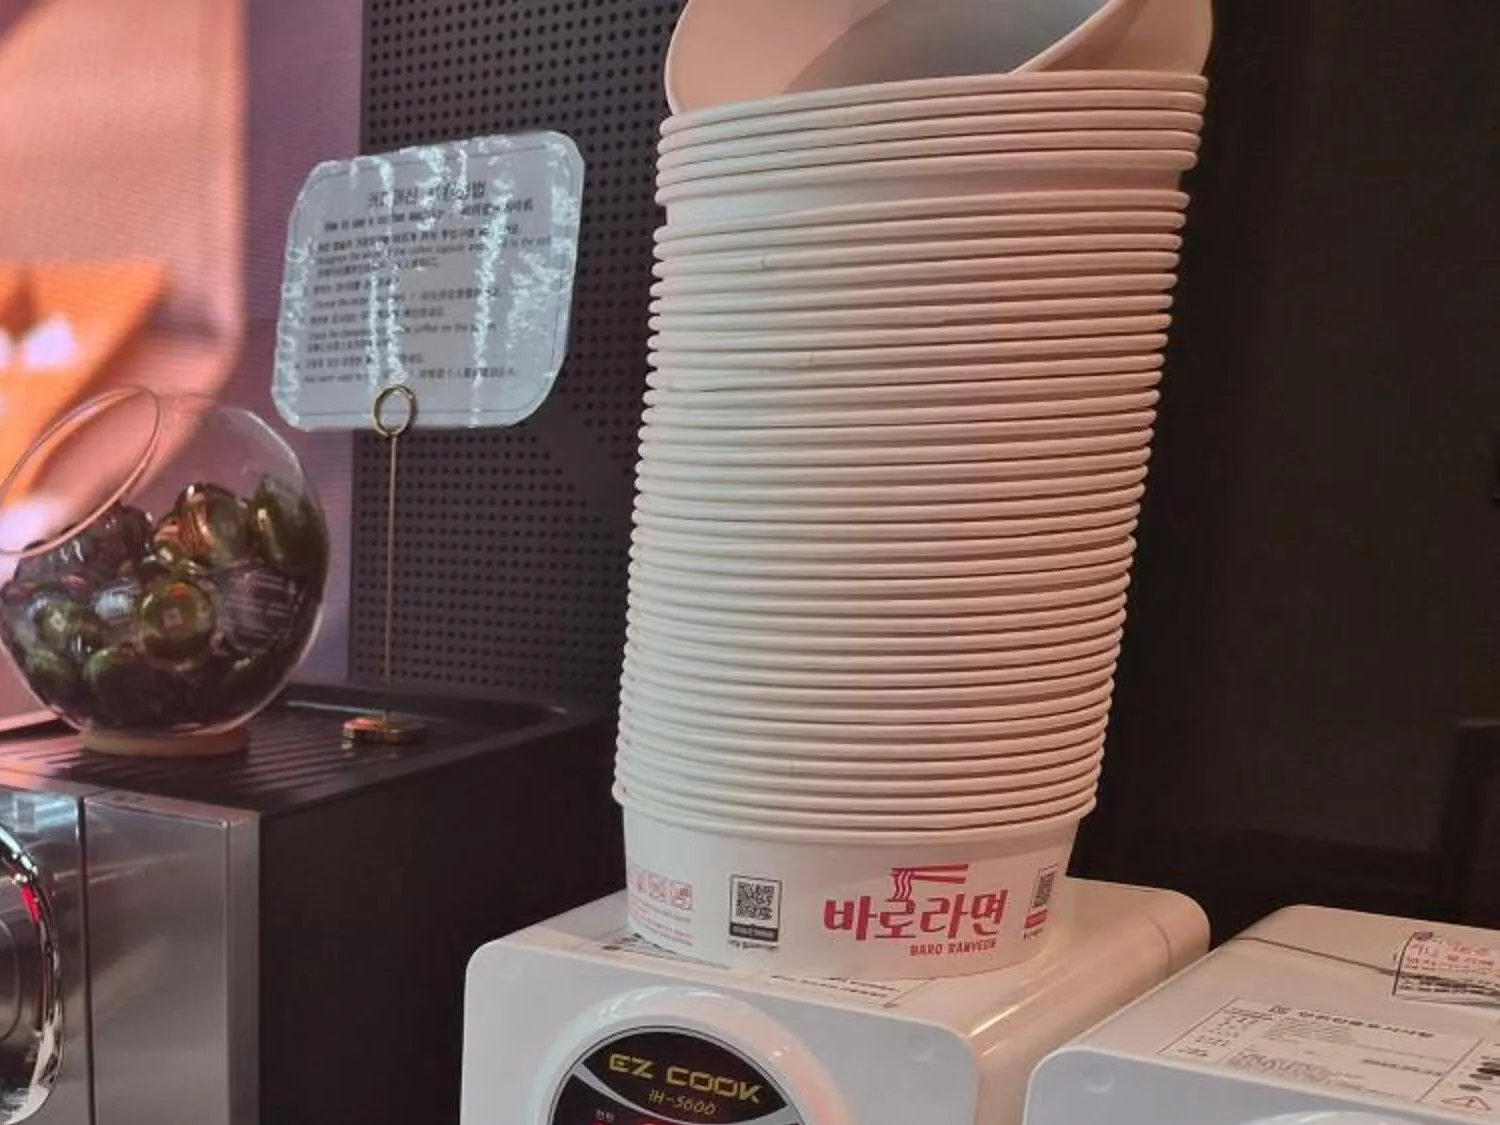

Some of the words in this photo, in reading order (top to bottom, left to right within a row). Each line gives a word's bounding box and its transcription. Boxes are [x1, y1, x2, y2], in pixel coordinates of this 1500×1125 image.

[823, 889, 1008, 941] 바로라면
[910, 943, 944, 957] BARO
[609, 1052, 655, 1080] EZ
[666, 1065, 764, 1104] COOK
[648, 1089, 716, 1115] IH-5600
